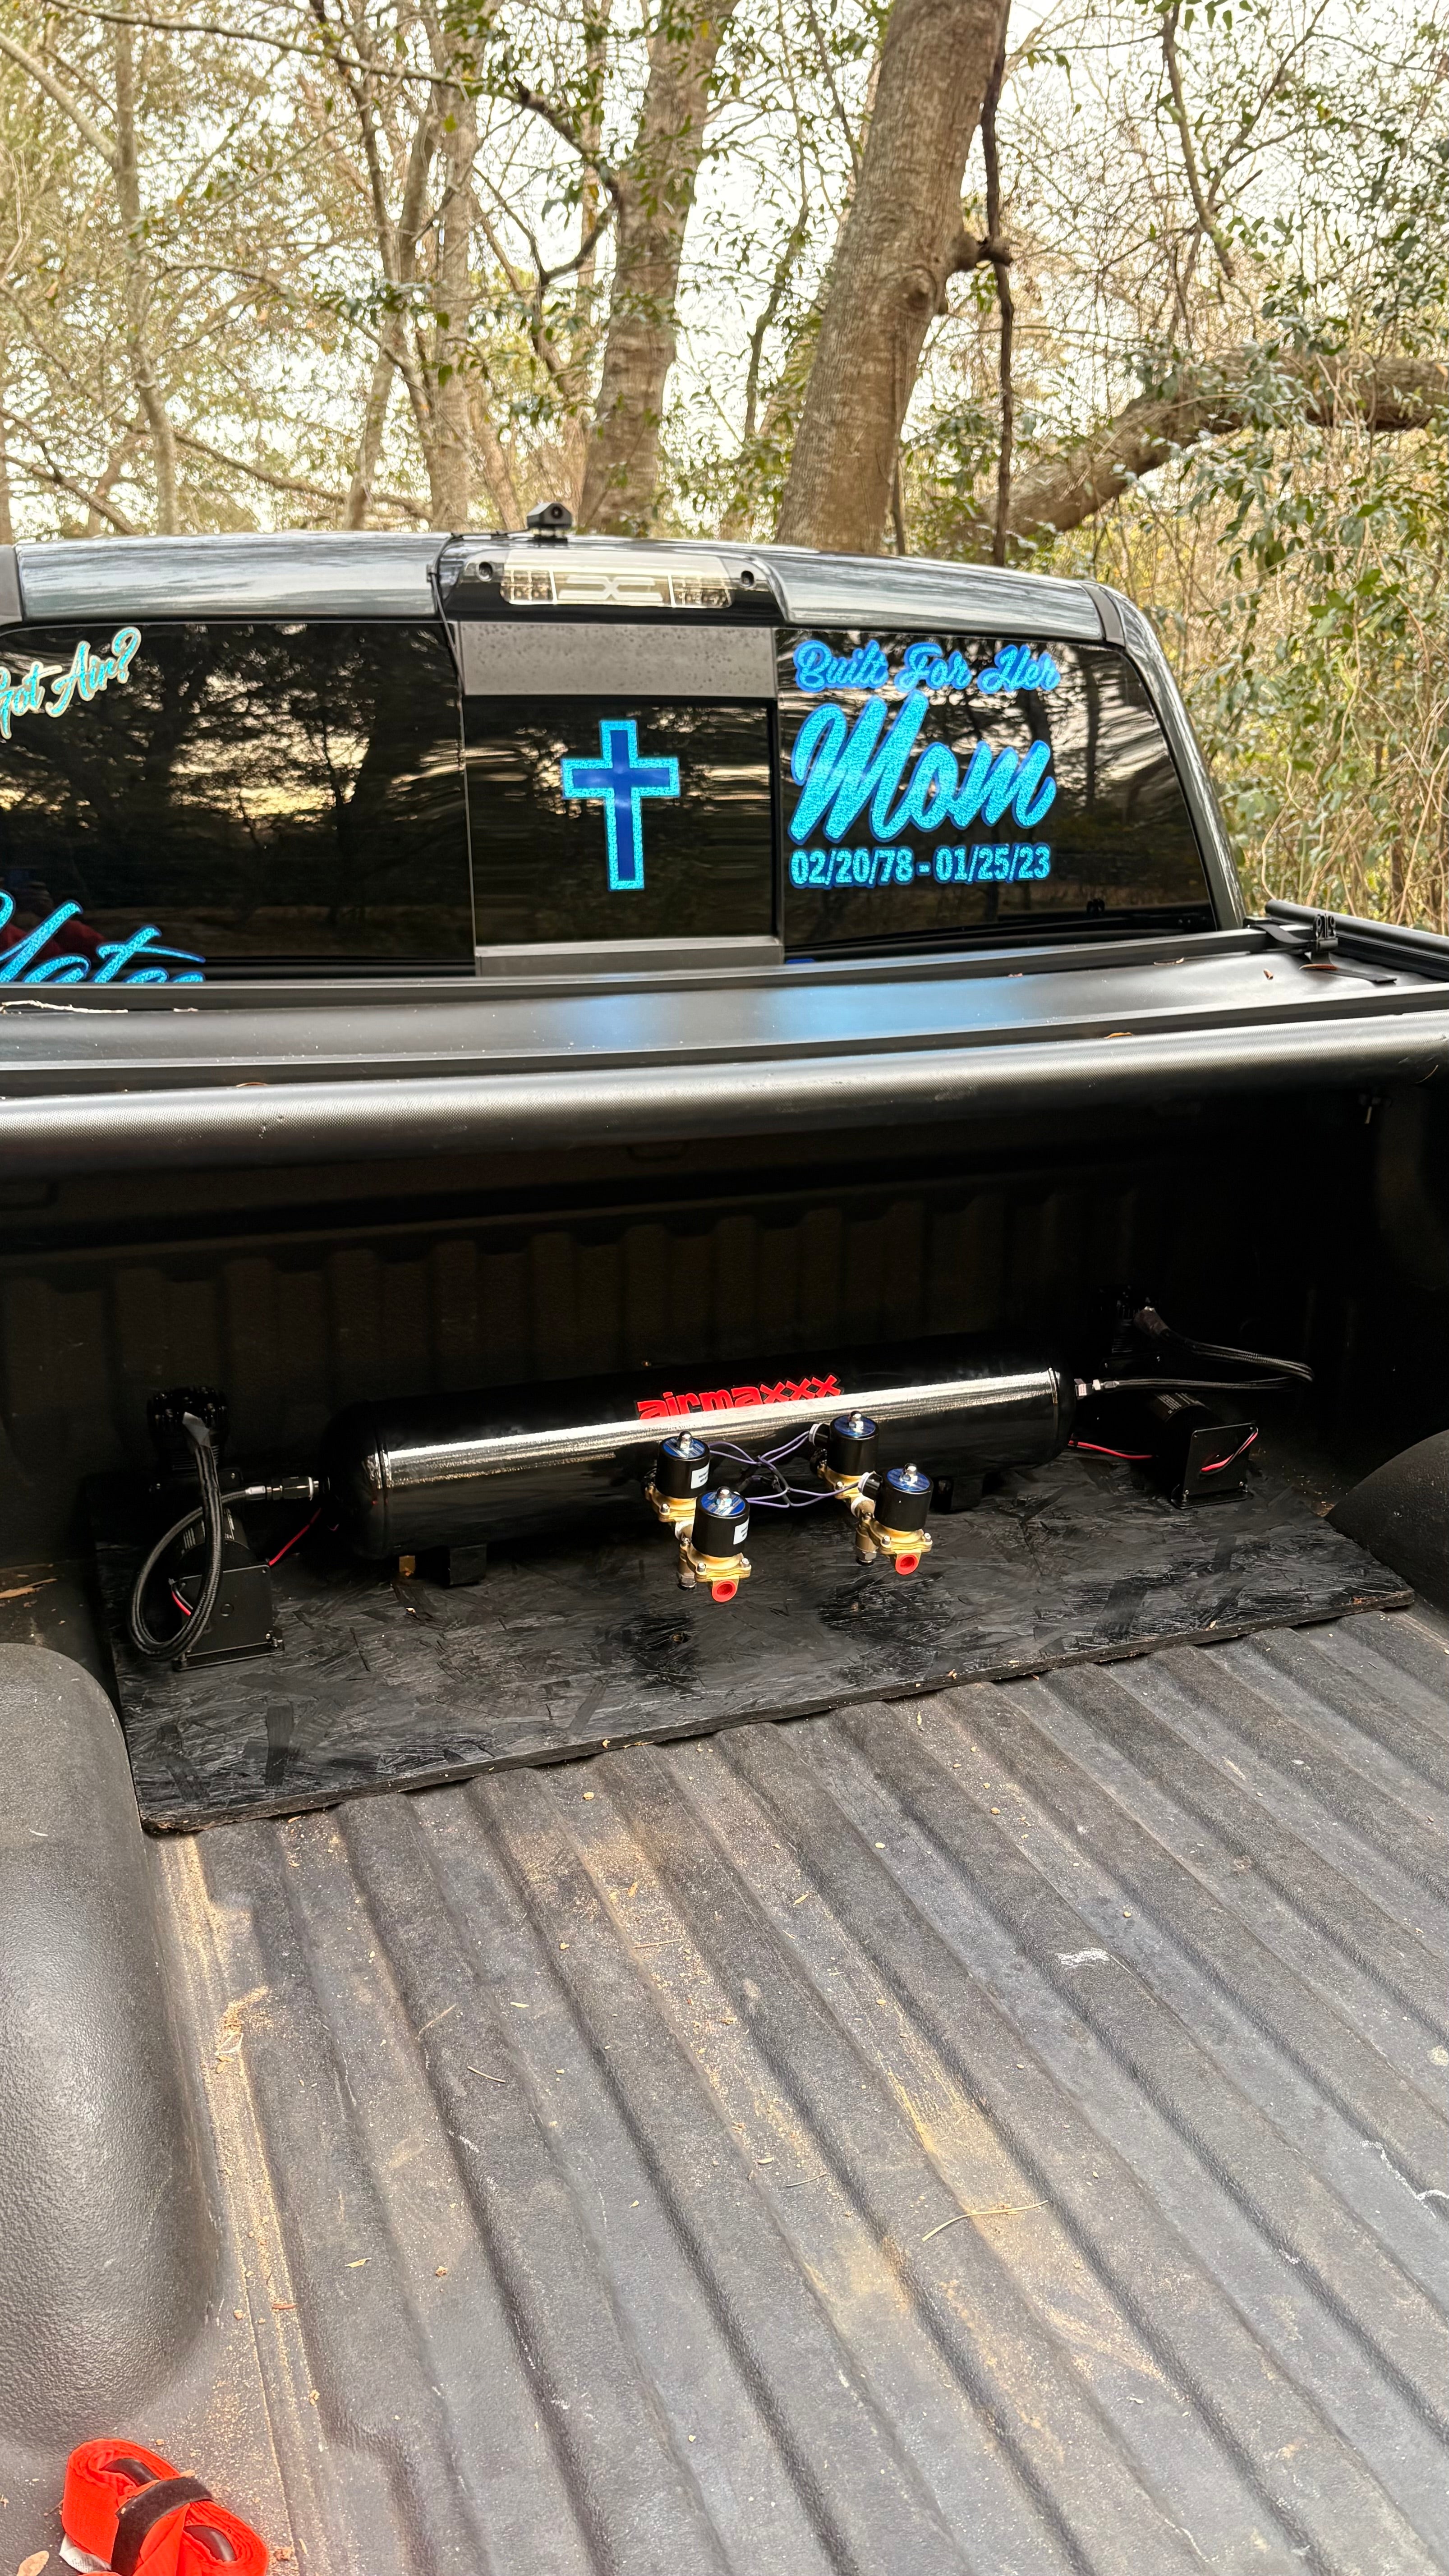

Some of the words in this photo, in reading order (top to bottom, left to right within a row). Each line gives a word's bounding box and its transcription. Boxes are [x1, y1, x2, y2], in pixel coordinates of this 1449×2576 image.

[46, 626, 141, 718] Air?
[793, 640, 889, 693] Built
[894, 642, 972, 693] For
[977, 644, 1060, 694] Her
[788, 690, 1056, 844] Mom
[790, 846, 914, 889] 02/20/78
[933, 842, 1050, 884] 01/25/23
[636, 1373, 843, 1426] airmaxxx
